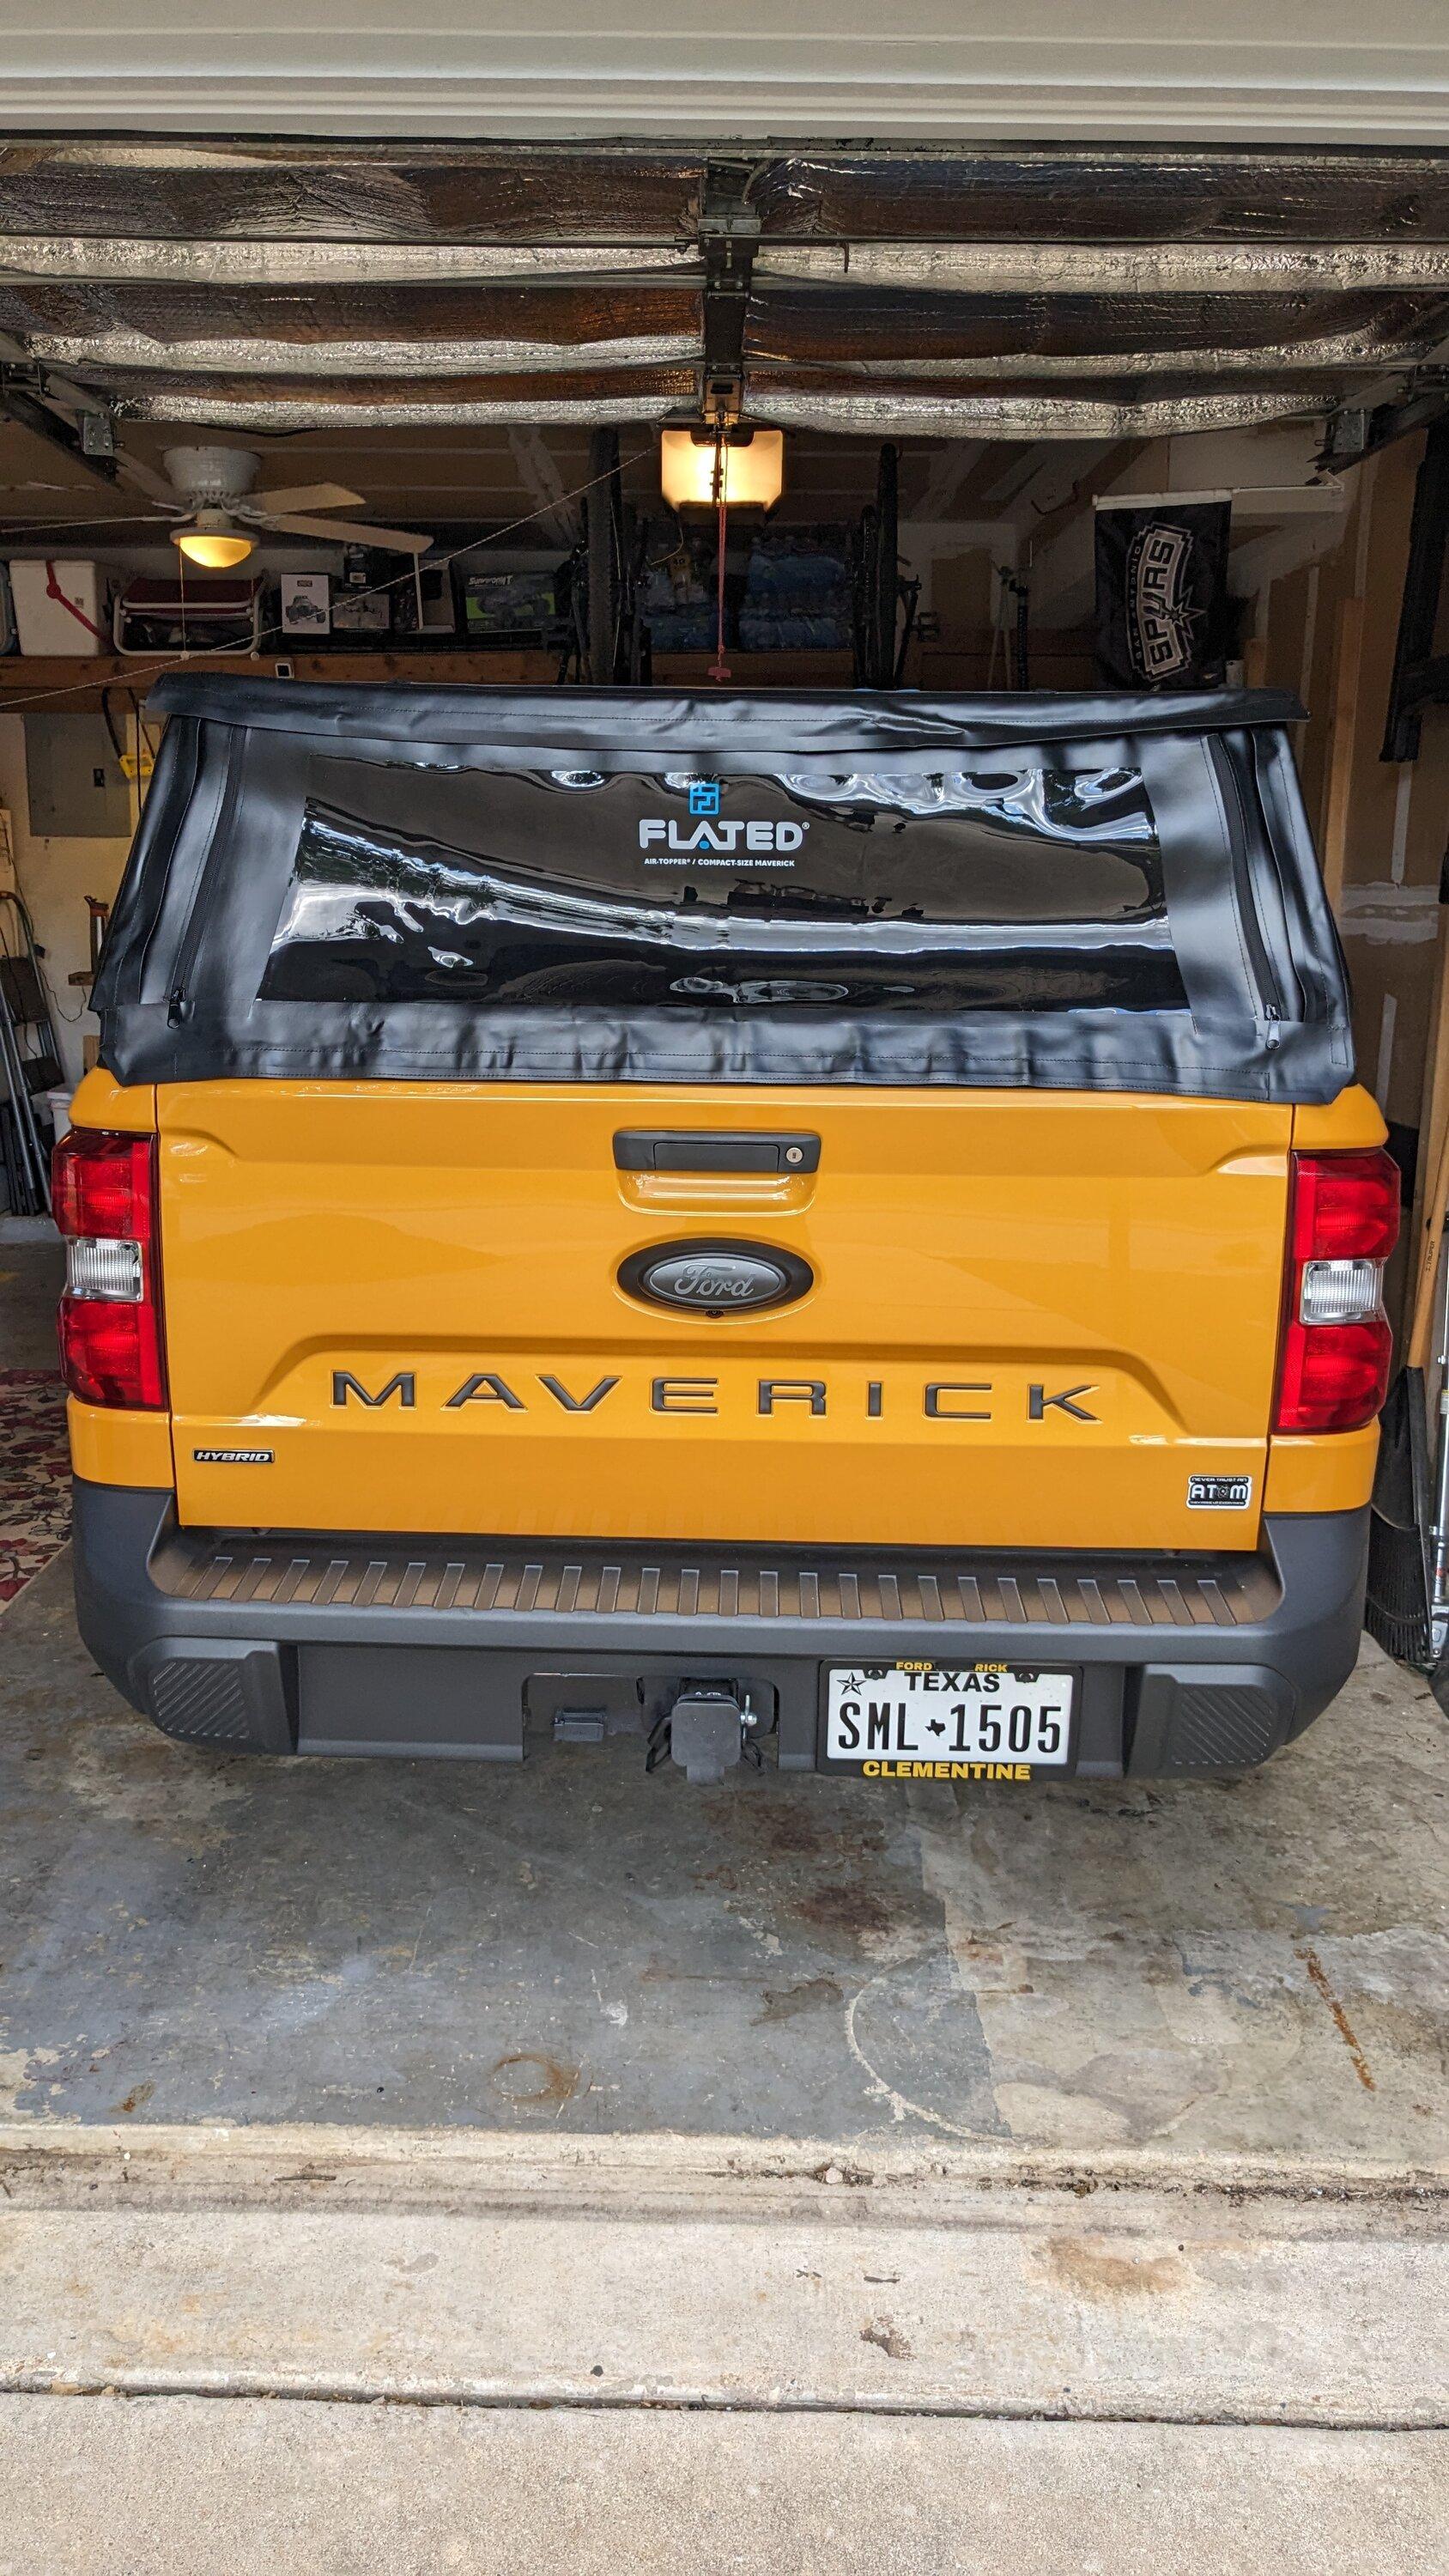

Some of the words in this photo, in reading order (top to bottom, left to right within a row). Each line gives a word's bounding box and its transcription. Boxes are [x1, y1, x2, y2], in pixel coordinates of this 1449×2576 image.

[1143, 538, 1176, 665] SPURS
[674, 1262, 755, 1297] Ford
[331, 1370, 1101, 1421] MAVERICK
[196, 1451, 270, 1461] HYBRID
[895, 1662, 933, 1671] FORD
[974, 1663, 1008, 1673] RICK
[904, 1672, 1000, 1693] TEXAS
[838, 1701, 919, 1751] SML
[949, 1704, 1062, 1753] 1505
[863, 1760, 1031, 1780] CLEMENTINE
